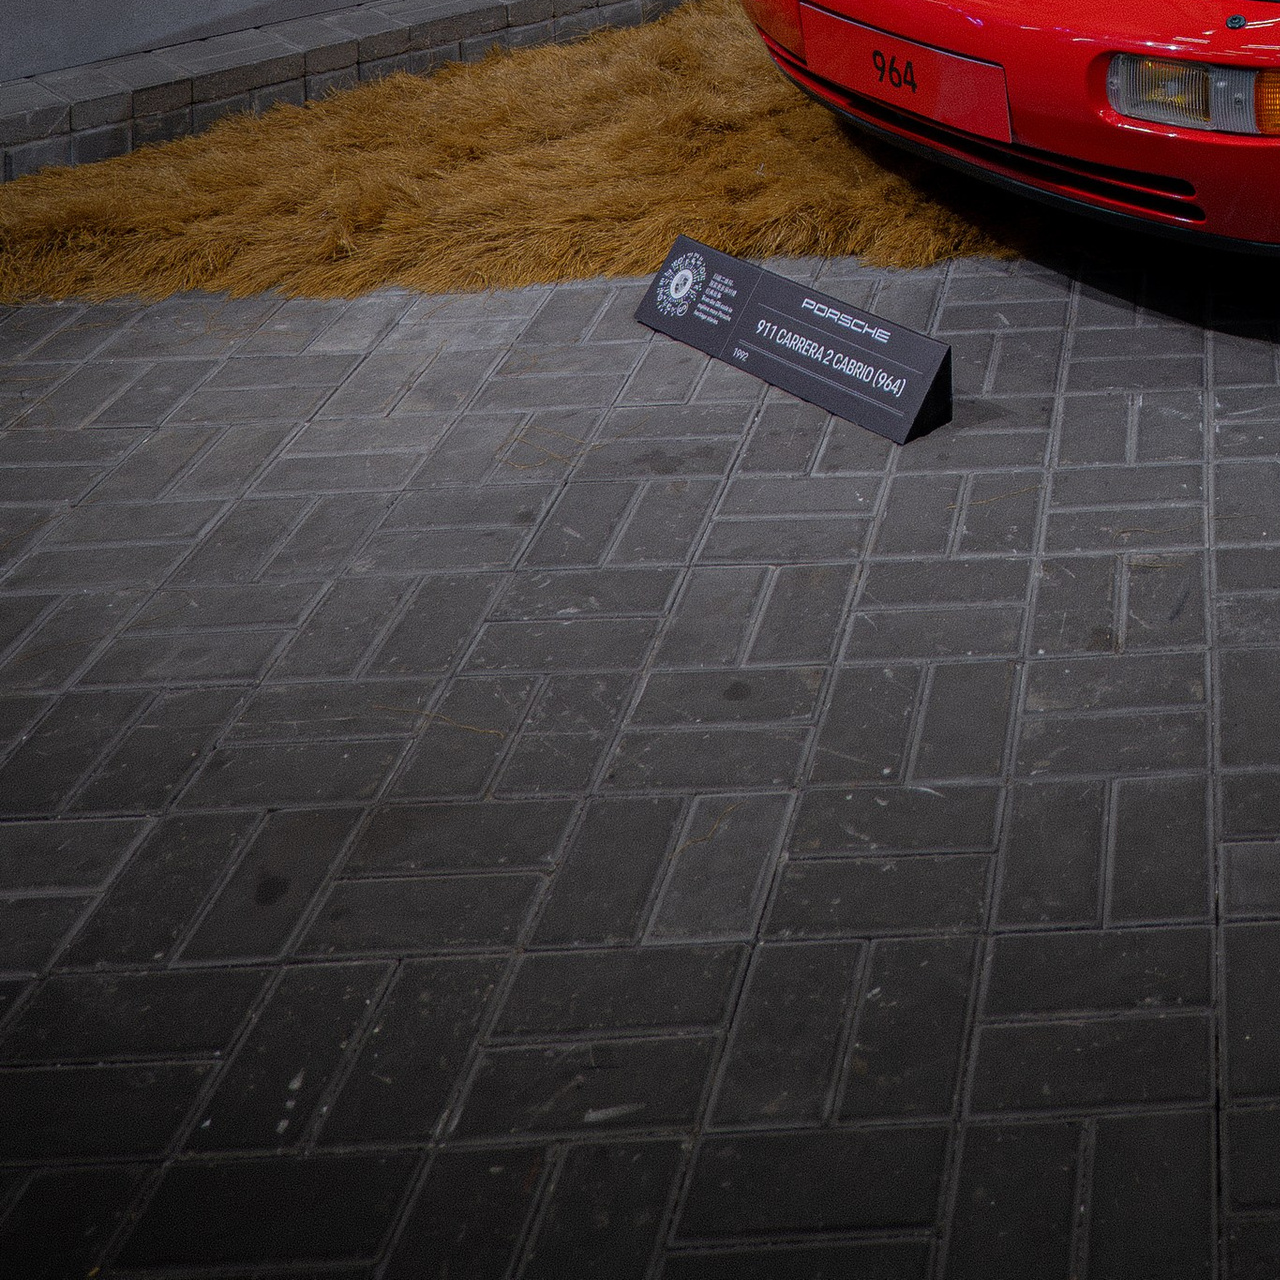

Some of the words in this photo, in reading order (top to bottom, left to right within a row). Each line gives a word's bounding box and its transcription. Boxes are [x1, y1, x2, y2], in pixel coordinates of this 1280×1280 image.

[871, 49, 918, 94] 964
[801, 297, 891, 343] PORSCHE
[732, 346, 749, 362] 1992
[755, 319, 776, 340] 911
[775, 327, 825, 362] CARRERA
[823, 349, 833, 365] 2
[832, 353, 874, 384] CABRIO
[872, 367, 906, 397] (964)
